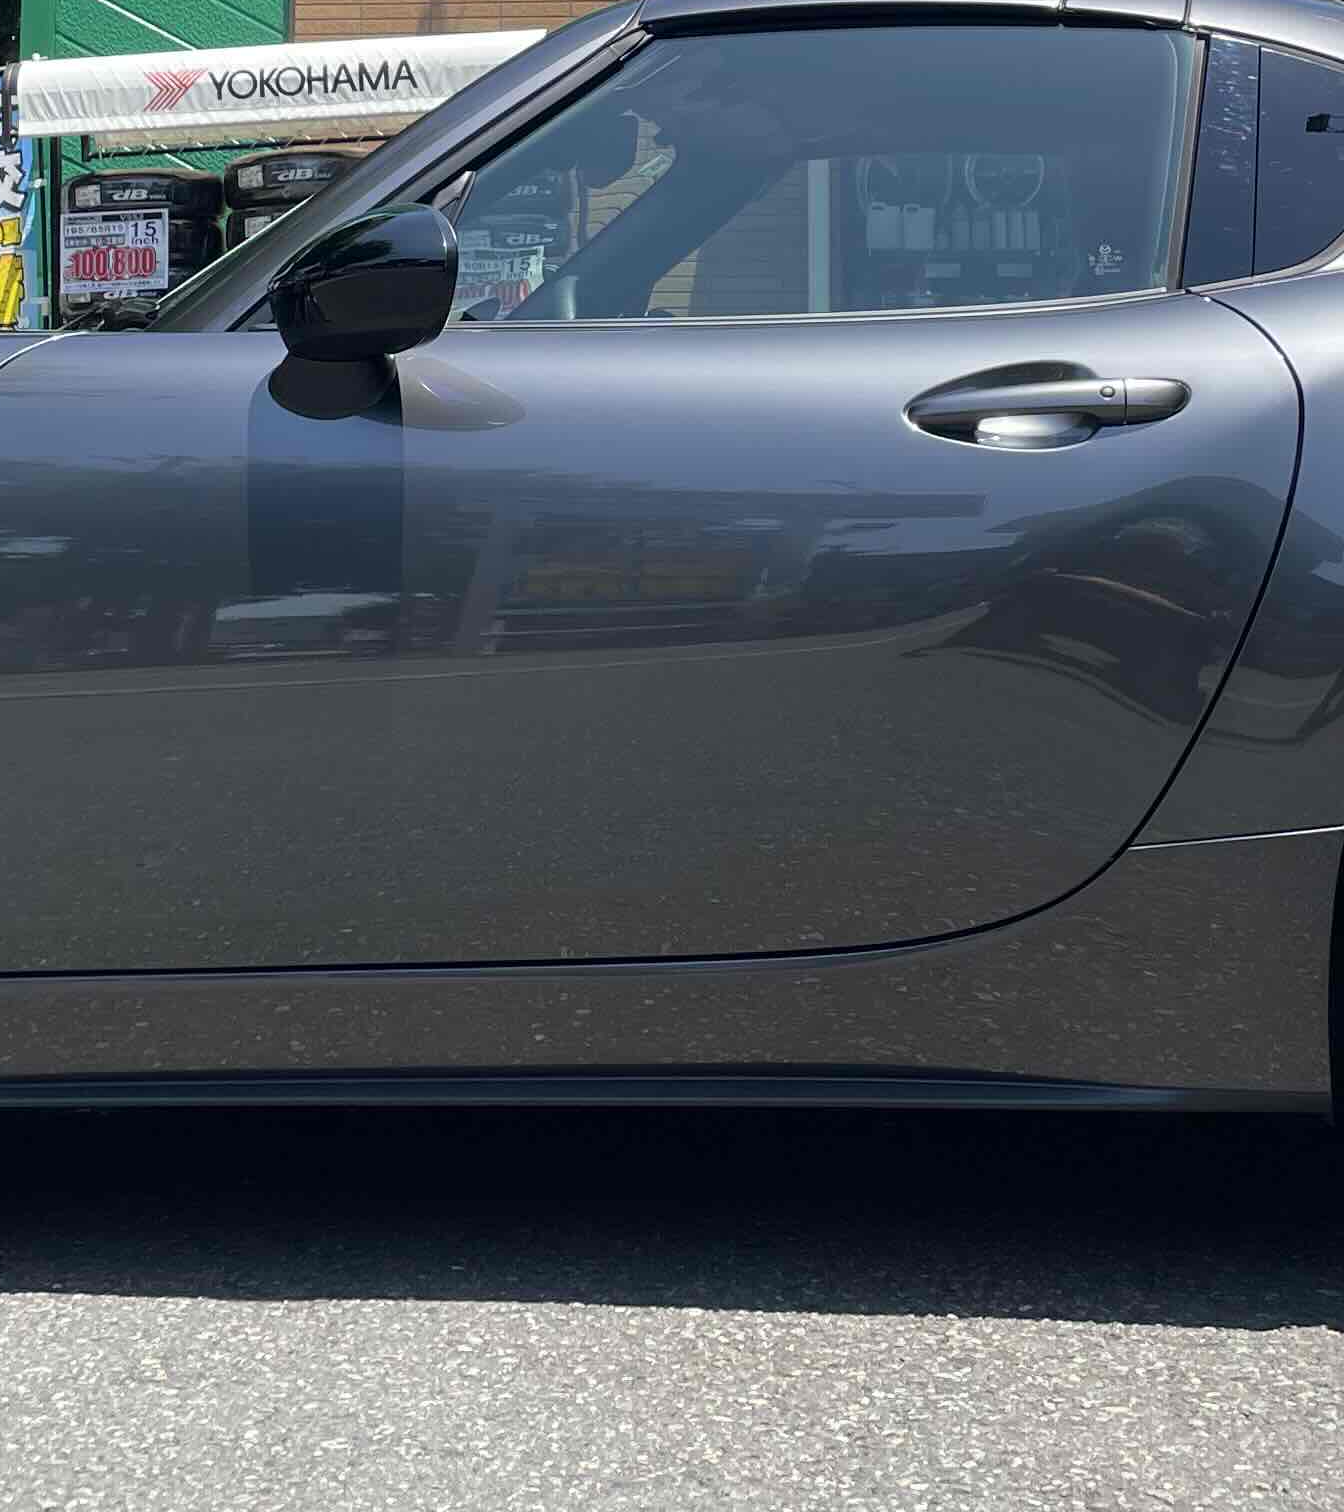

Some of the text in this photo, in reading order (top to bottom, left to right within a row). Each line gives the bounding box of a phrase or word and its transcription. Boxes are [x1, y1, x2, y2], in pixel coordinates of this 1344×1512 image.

[208, 59, 419, 101] YOKOHAMA
[131, 220, 157, 238] 15
[131, 238, 159, 246] inch
